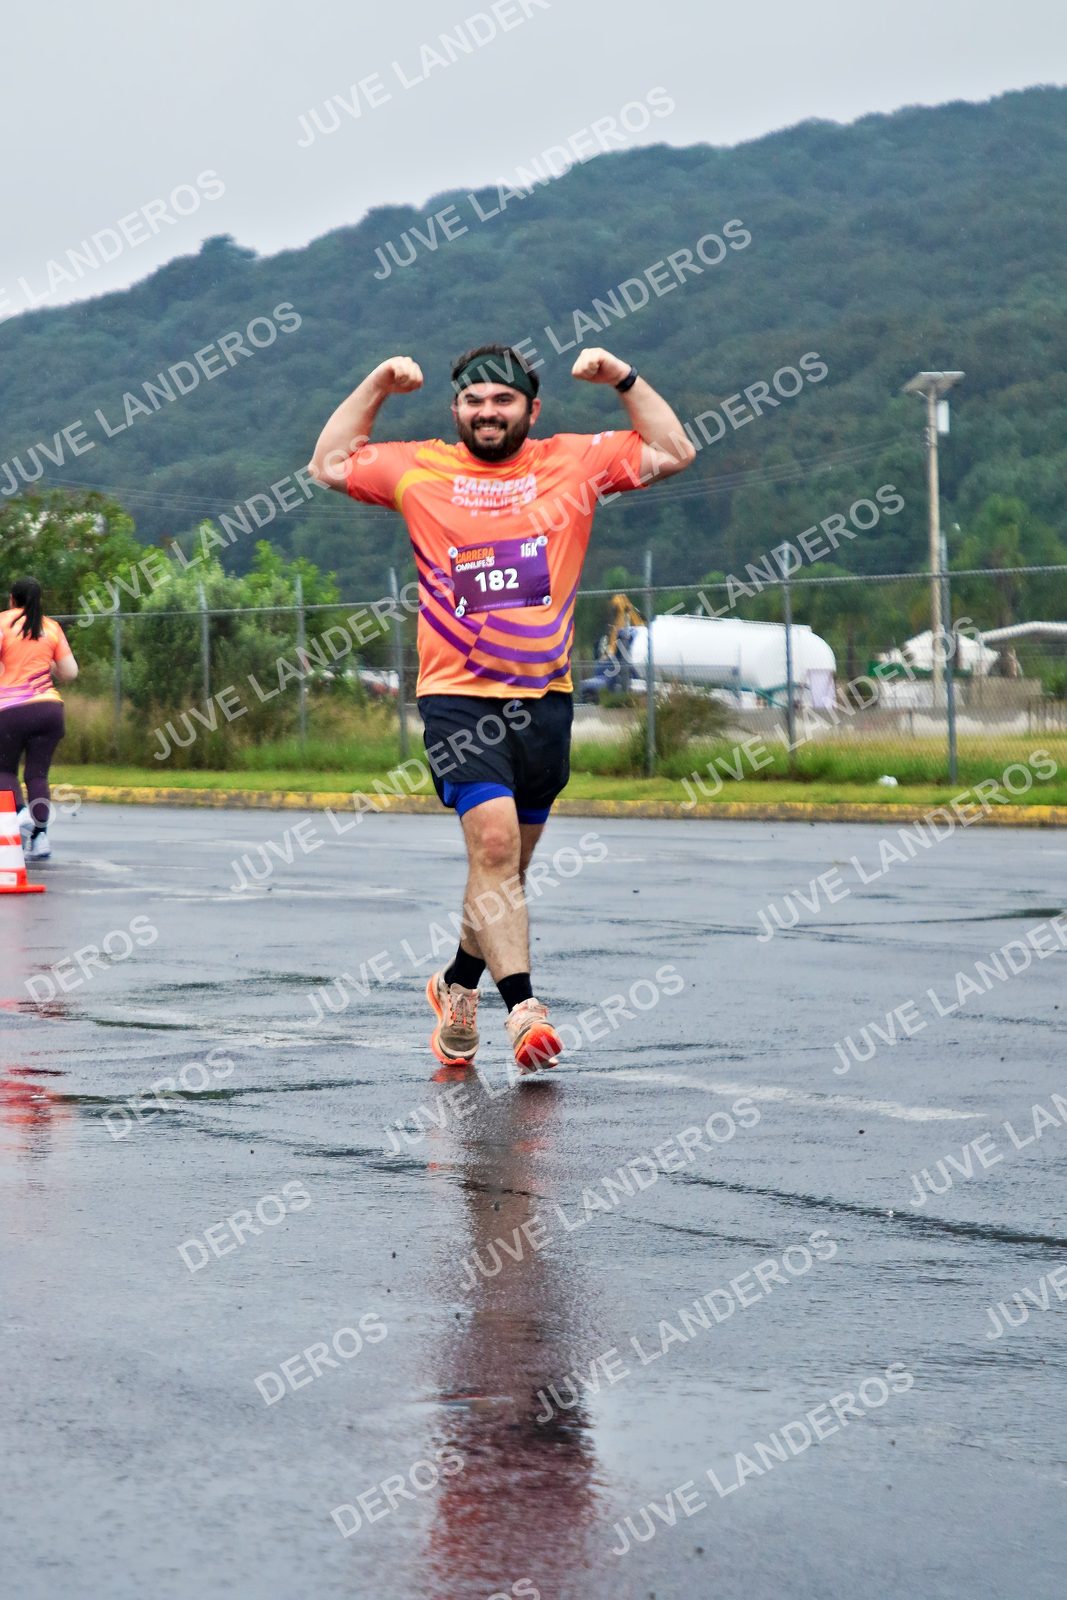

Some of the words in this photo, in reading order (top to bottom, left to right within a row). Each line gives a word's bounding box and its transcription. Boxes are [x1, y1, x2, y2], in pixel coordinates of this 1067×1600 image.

[453, 473, 536, 496] CARRERA
[455, 559, 487, 572] OMNILIFE
[456, 547, 495, 564] CARRERA
[474, 568, 519, 592] 182
